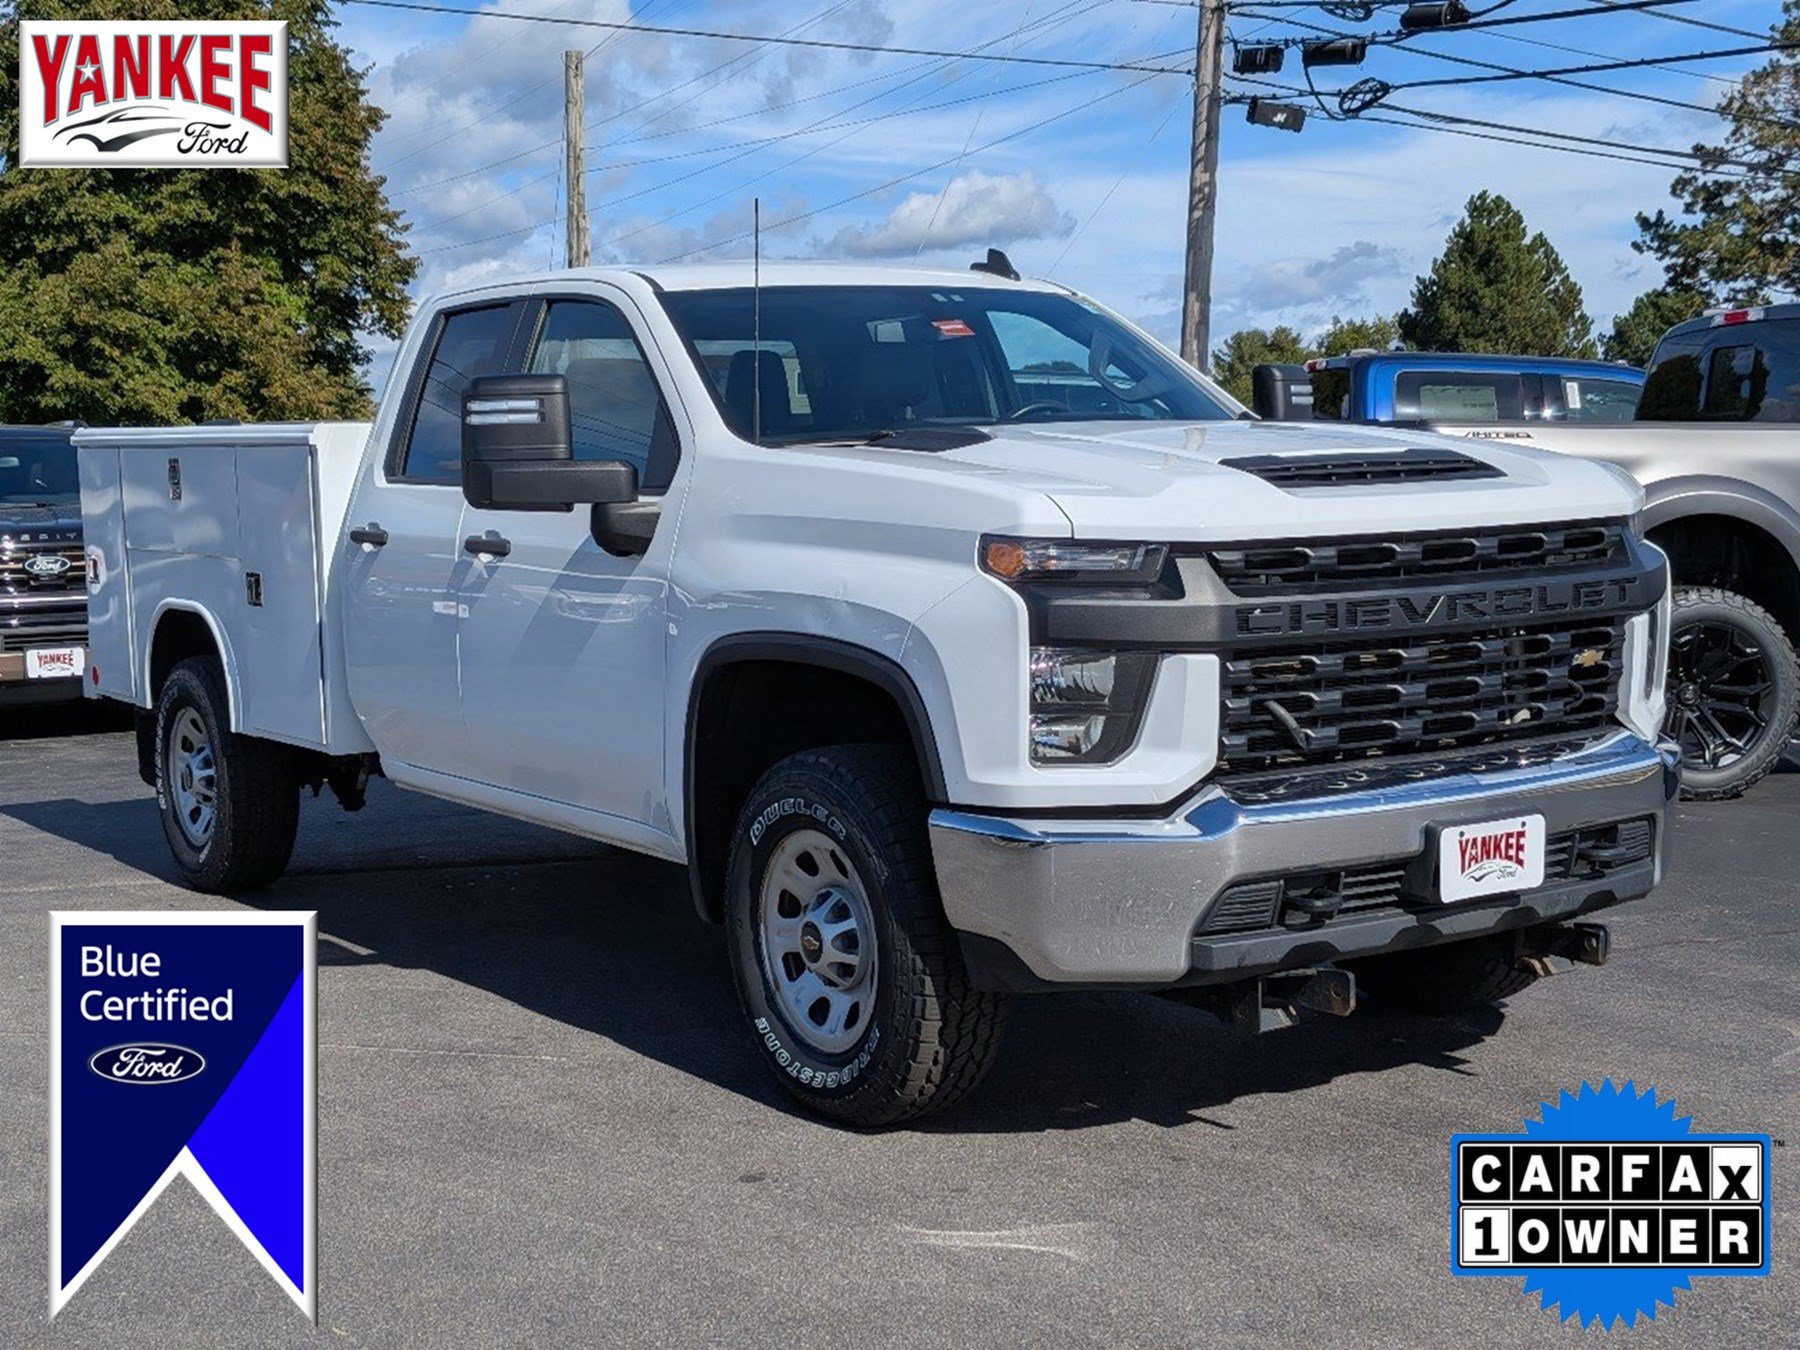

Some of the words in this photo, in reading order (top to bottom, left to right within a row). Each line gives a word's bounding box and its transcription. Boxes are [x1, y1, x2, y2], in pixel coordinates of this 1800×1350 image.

[1235, 576, 1640, 637] CHEVROLET
[37, 653, 73, 668] YANKEE
[750, 798, 846, 846] DUELER
[1458, 831, 1526, 876] YANKEE
